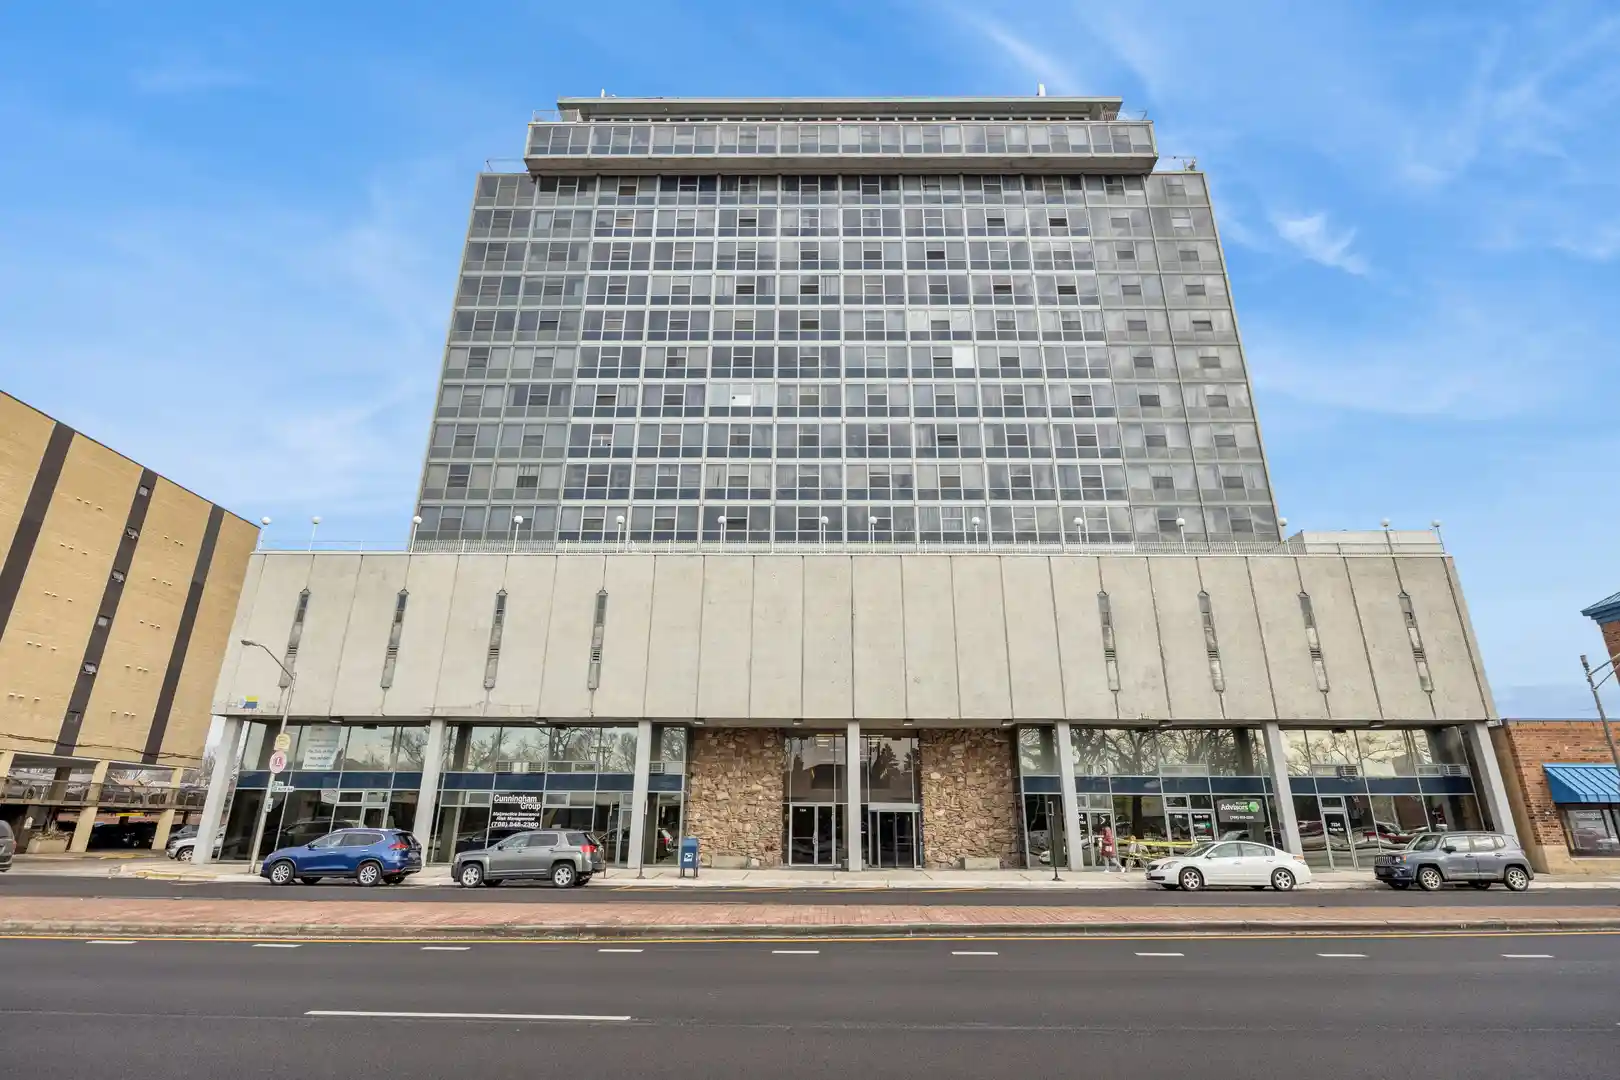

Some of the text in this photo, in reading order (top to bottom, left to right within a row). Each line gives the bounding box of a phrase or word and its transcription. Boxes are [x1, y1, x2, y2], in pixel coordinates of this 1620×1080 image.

[494, 794, 537, 804] Cunningham
[520, 803, 541, 811] Group
[1221, 803, 1249, 811] Advisors
